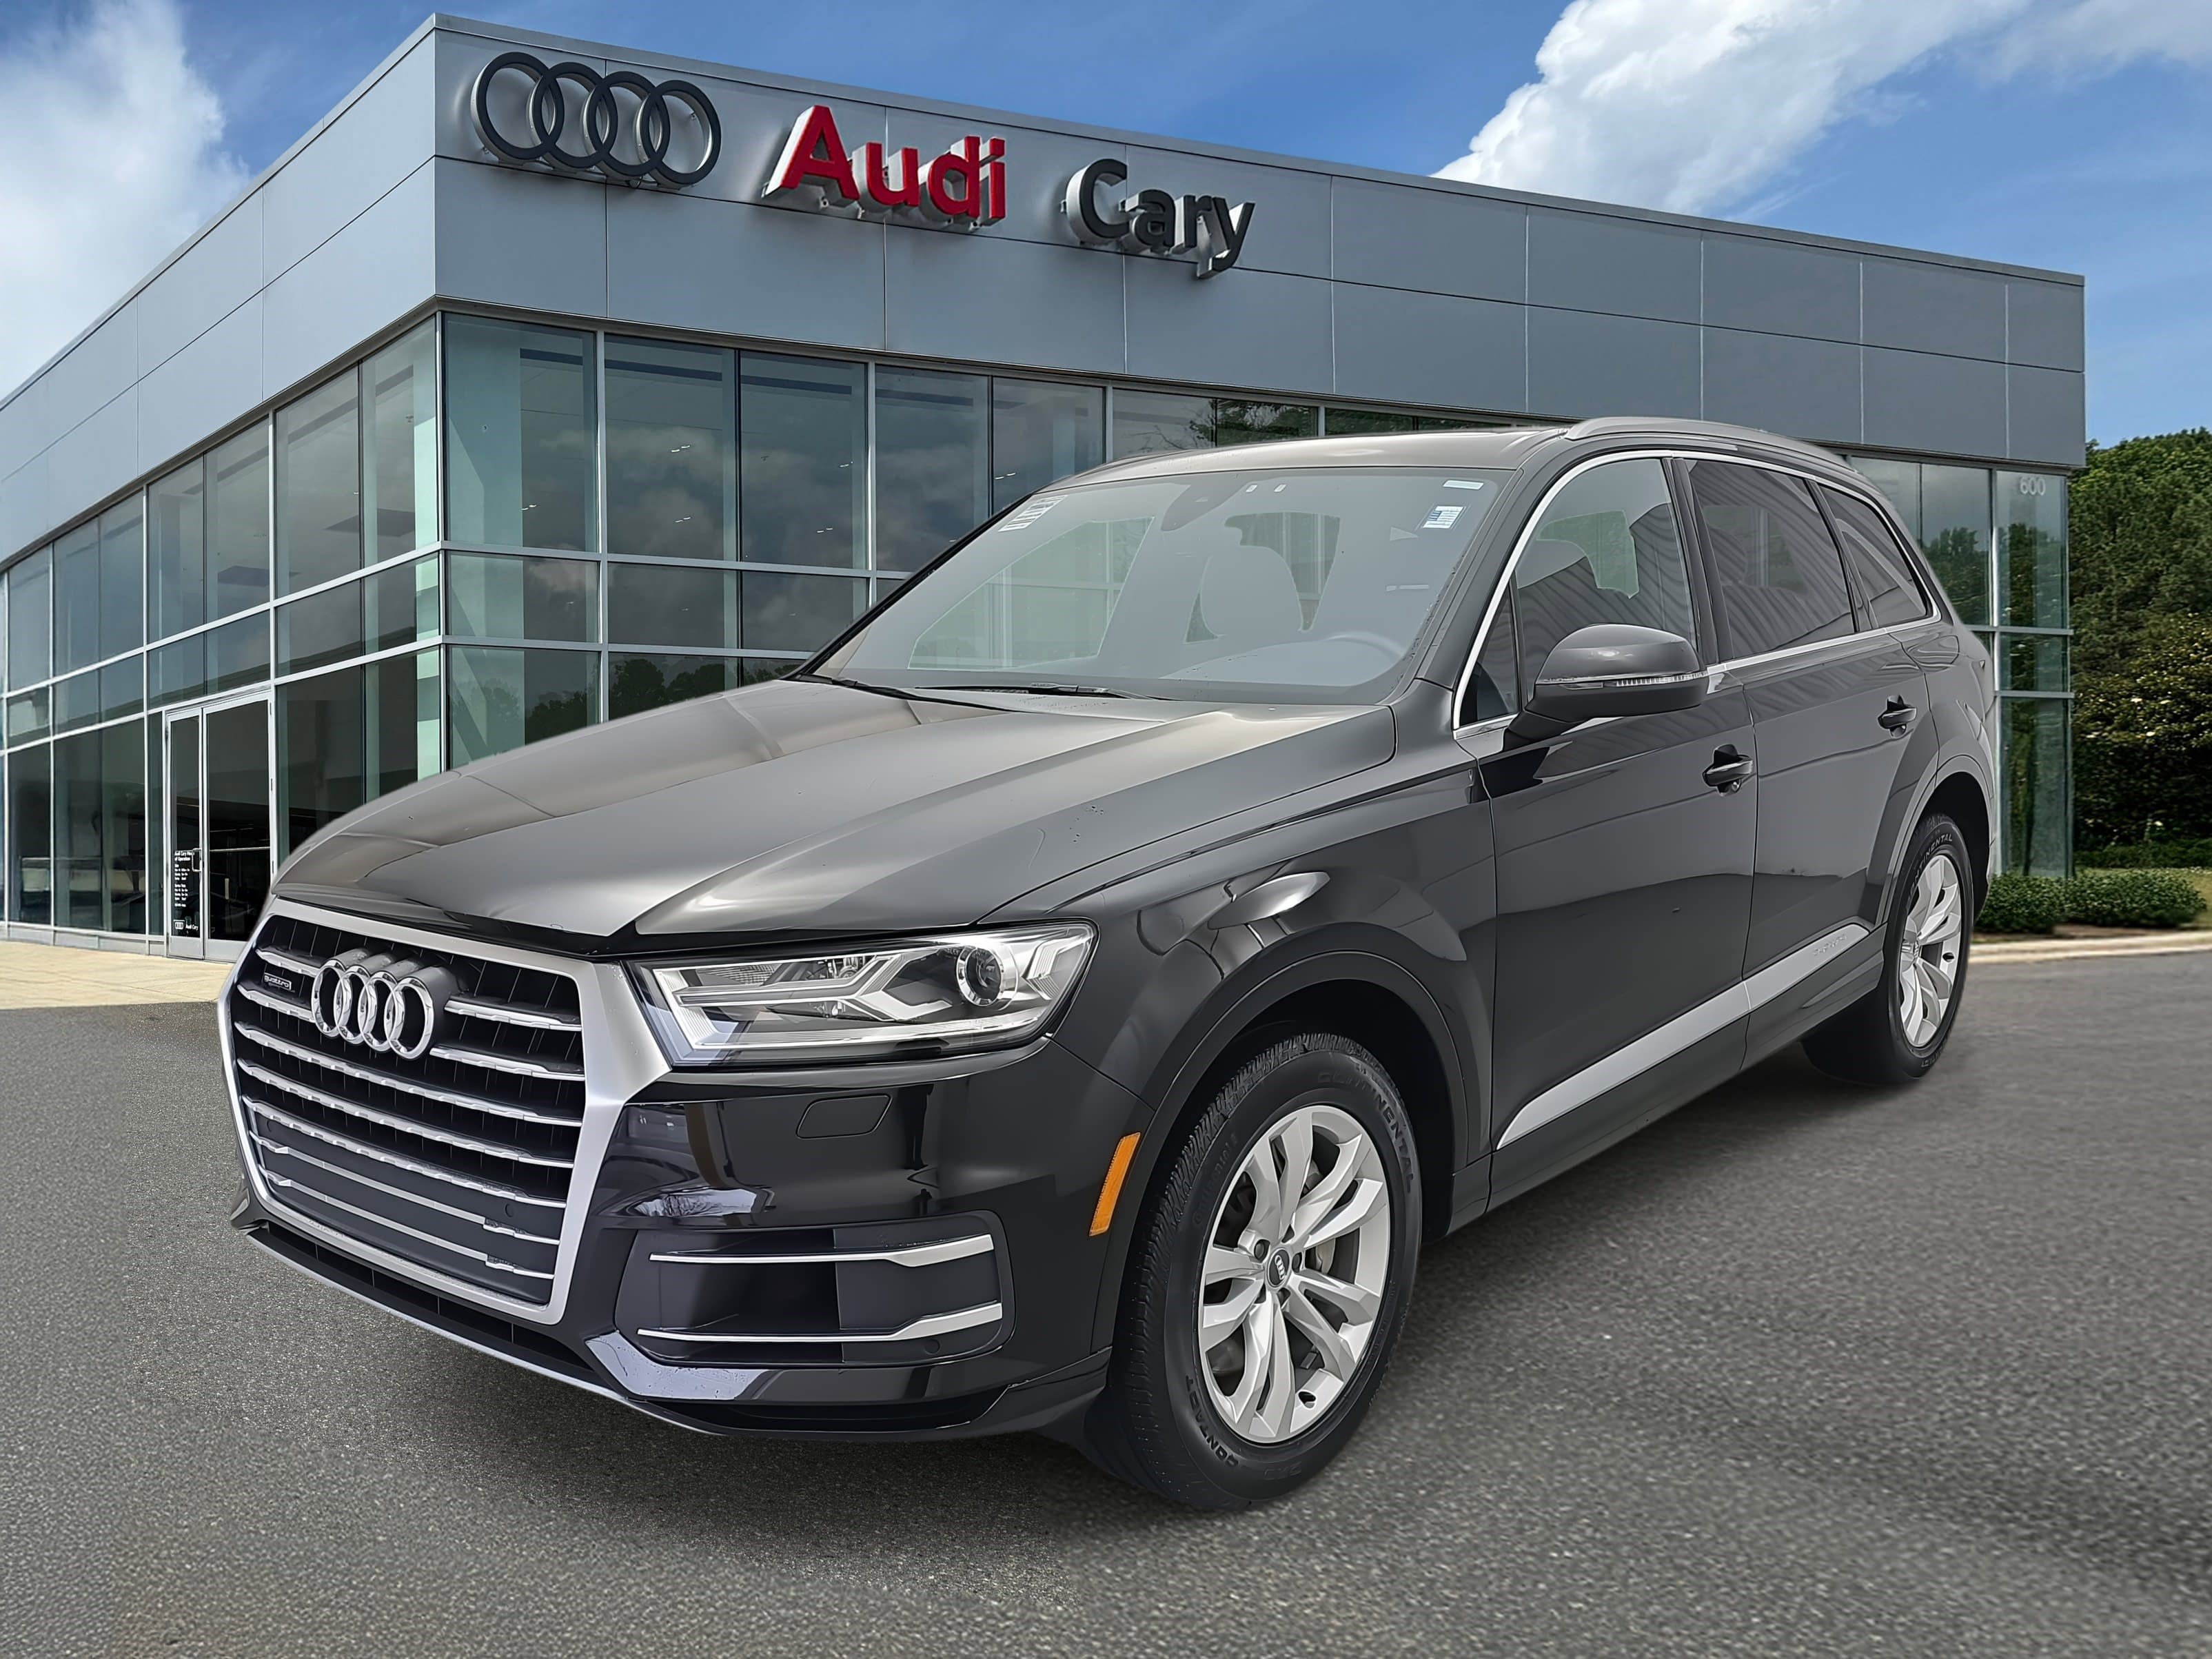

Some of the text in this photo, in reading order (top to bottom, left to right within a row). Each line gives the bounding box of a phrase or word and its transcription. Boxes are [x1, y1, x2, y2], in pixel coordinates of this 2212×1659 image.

[775, 105, 1256, 273] Audi Cary
[2020, 476, 2045, 496] 600
[1318, 1070, 1413, 1194] CINENTAL
